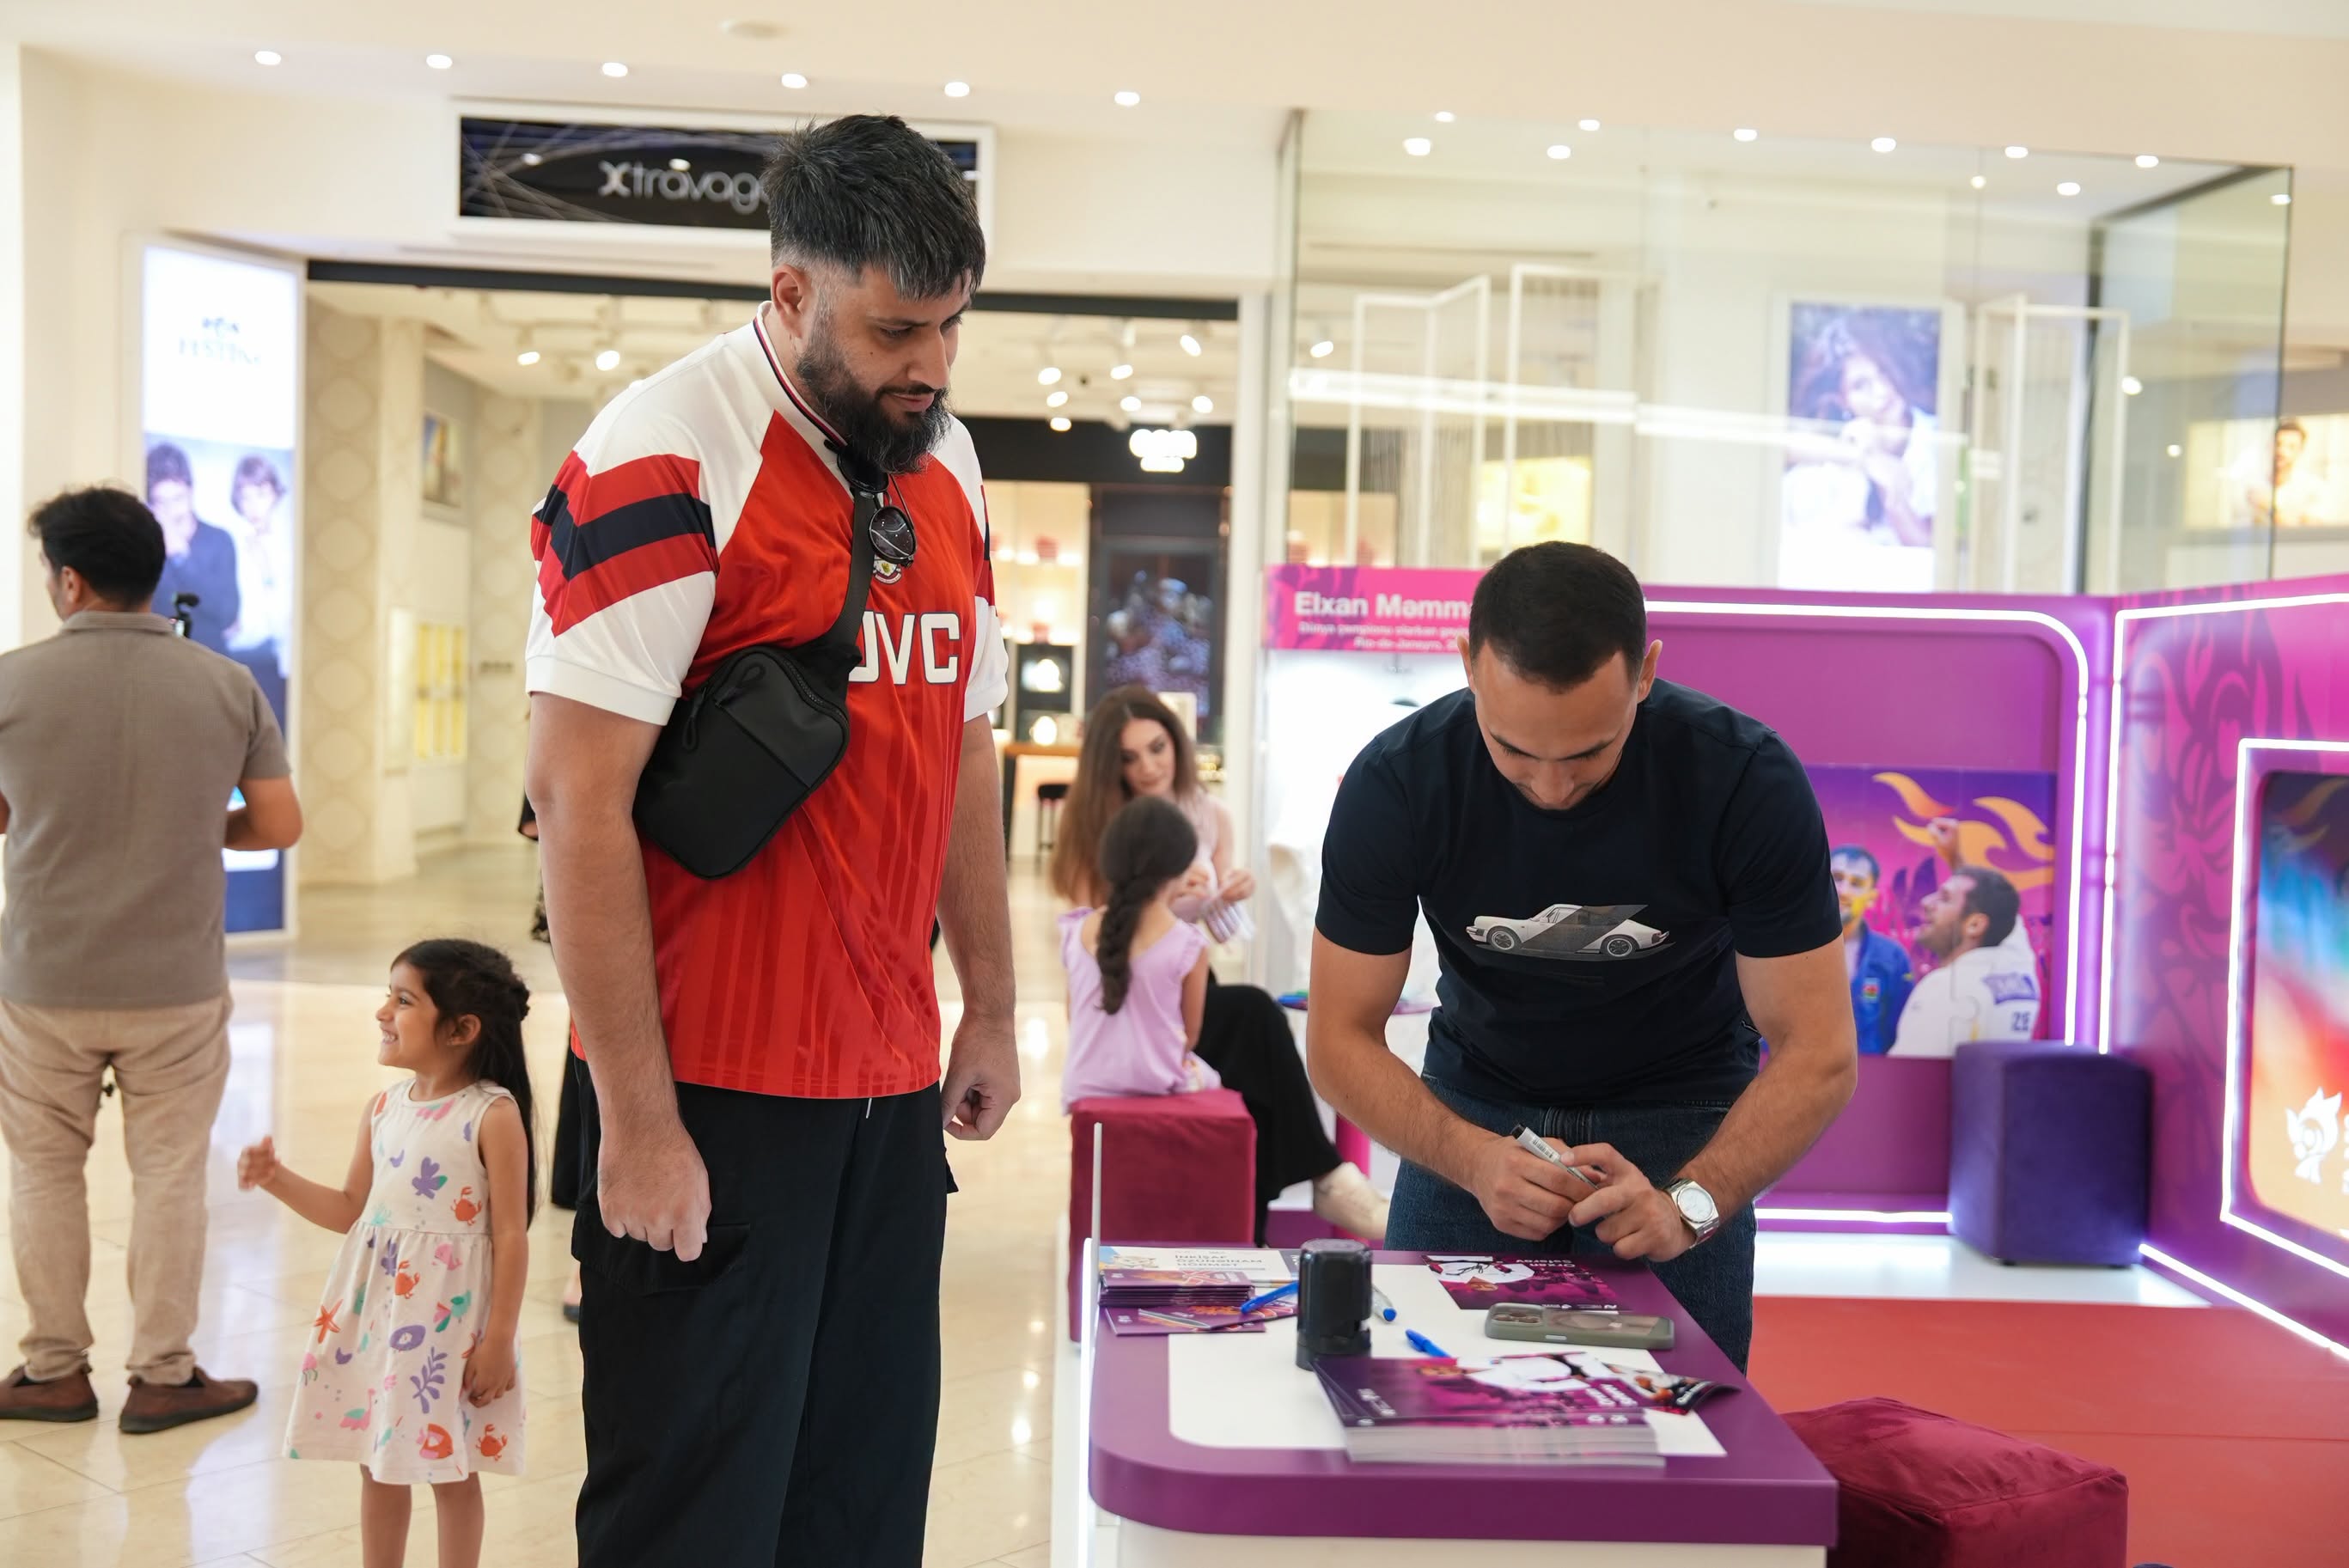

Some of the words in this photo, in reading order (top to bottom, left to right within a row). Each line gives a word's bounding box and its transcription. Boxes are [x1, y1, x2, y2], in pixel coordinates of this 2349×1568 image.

[599, 160, 767, 214] Xtravag
[1295, 591, 1368, 616] Elxan
[1376, 594, 1471, 619] Məmm
[849, 611, 960, 684] JVC
